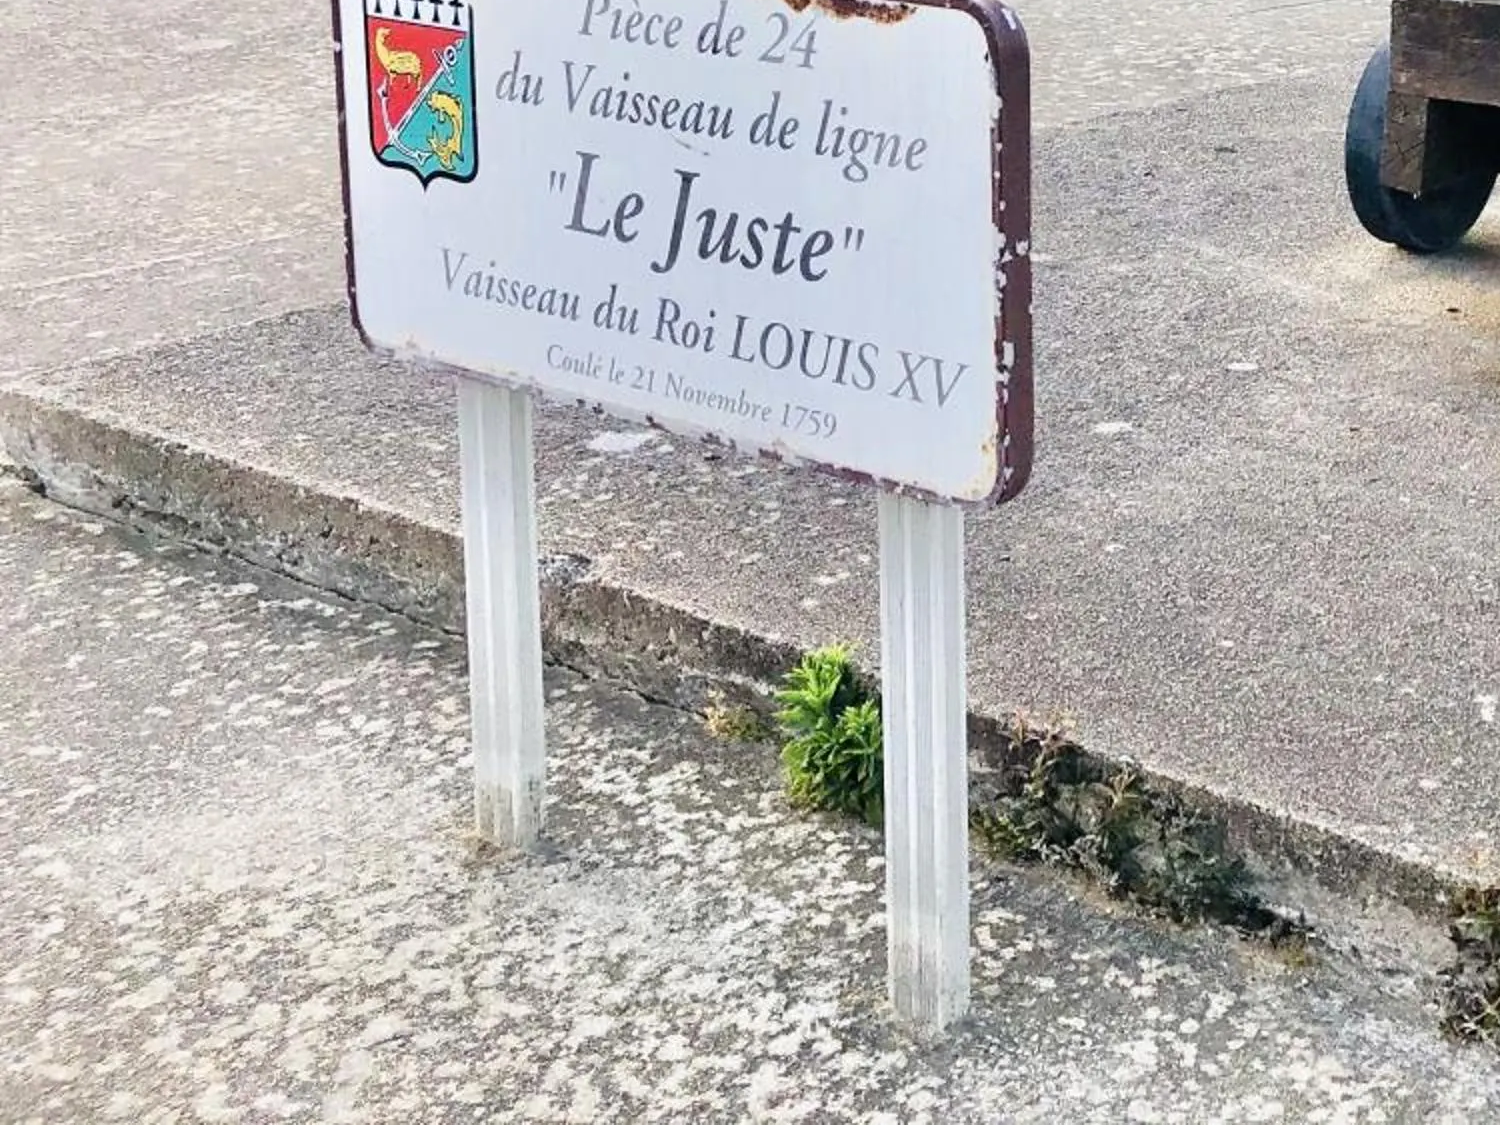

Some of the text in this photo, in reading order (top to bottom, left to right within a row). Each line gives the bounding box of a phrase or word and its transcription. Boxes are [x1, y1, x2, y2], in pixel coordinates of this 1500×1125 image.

[699, 0, 747, 56] de
[758, 12, 818, 69] 24
[496, 51, 928, 182] du Vaisseau de ligne
[548, 151, 865, 281] "Le Juste"
[441, 249, 969, 408] Vaisseau du Roi LOUIS XV
[546, 344, 837, 437] Coulé le 21 Novembre 1759
